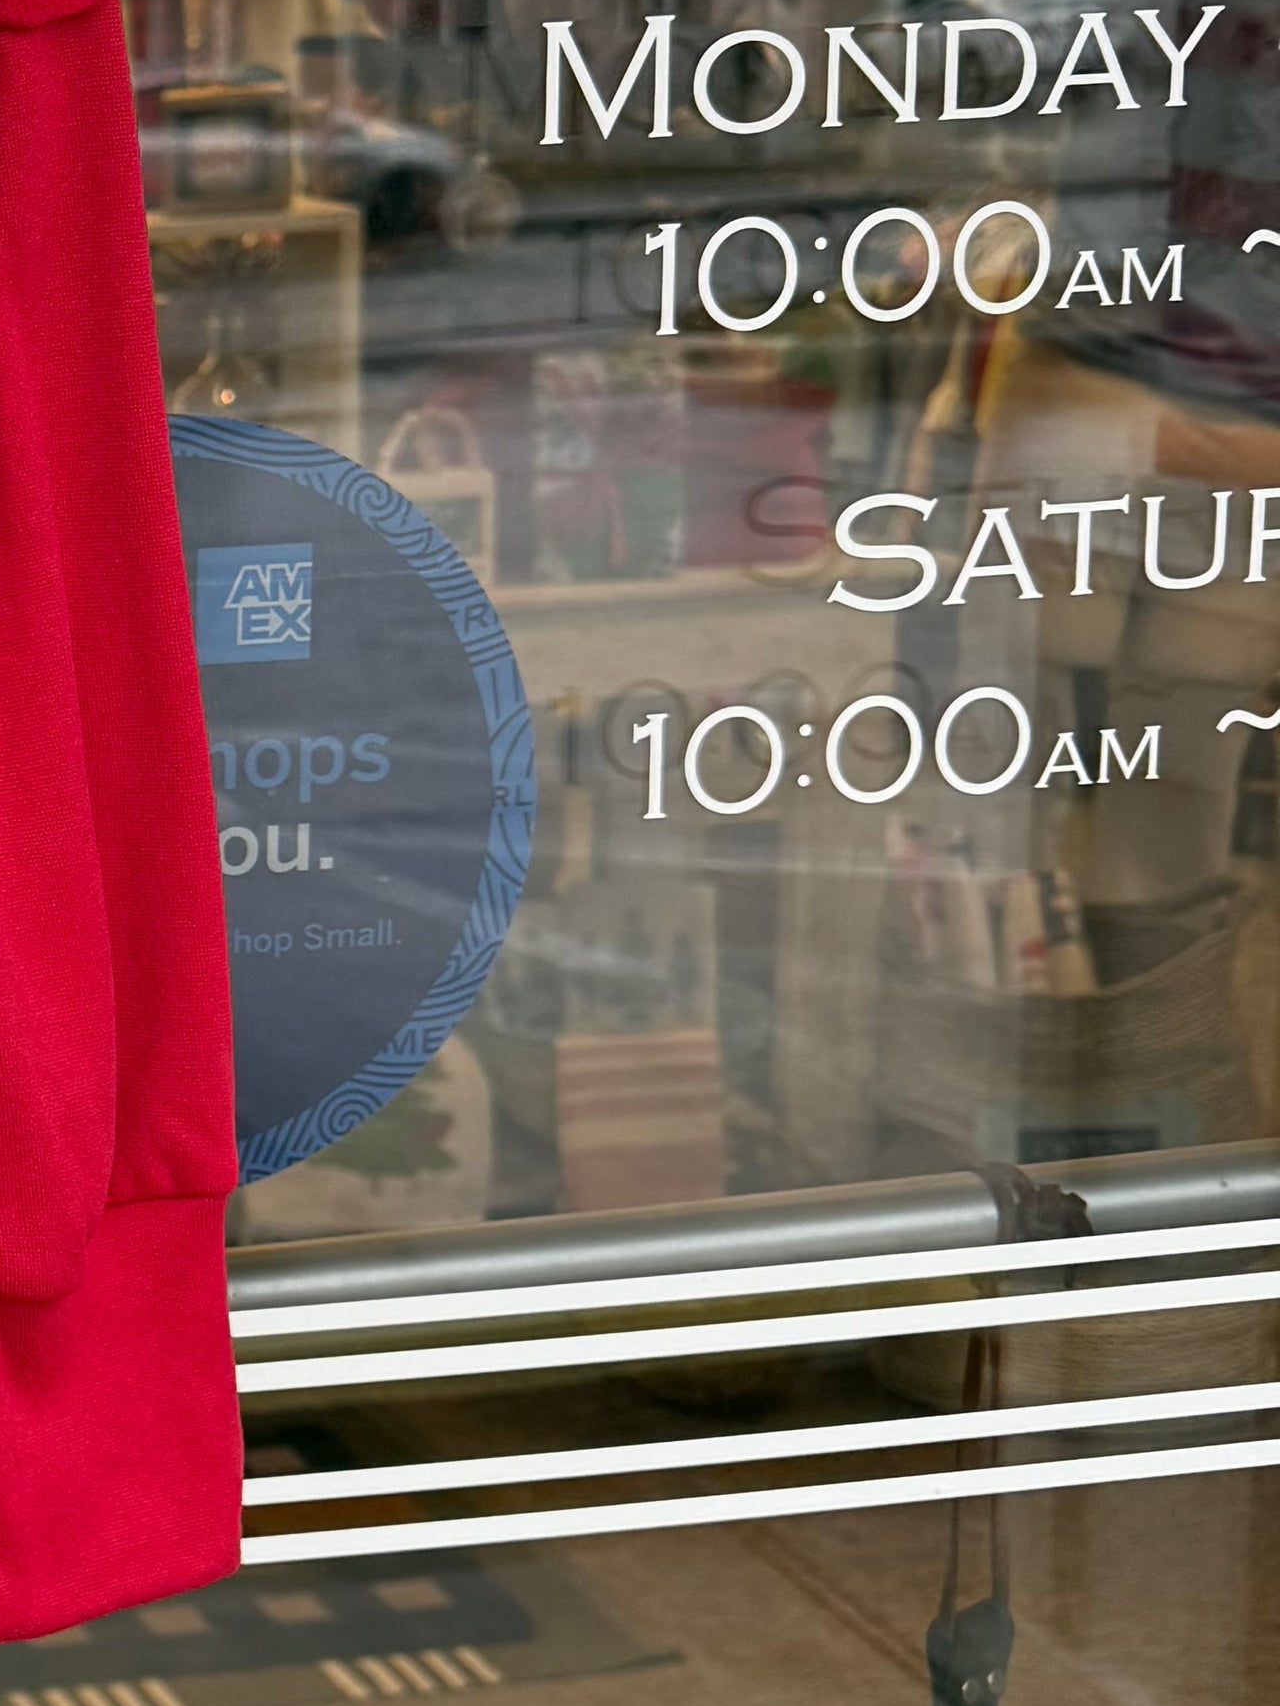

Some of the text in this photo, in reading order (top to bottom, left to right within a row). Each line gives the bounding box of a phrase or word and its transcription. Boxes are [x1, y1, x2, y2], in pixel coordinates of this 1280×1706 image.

[539, 4, 1227, 146] MONDAY
[218, 822, 334, 876] ou.
[303, 918, 403, 951] Small.
